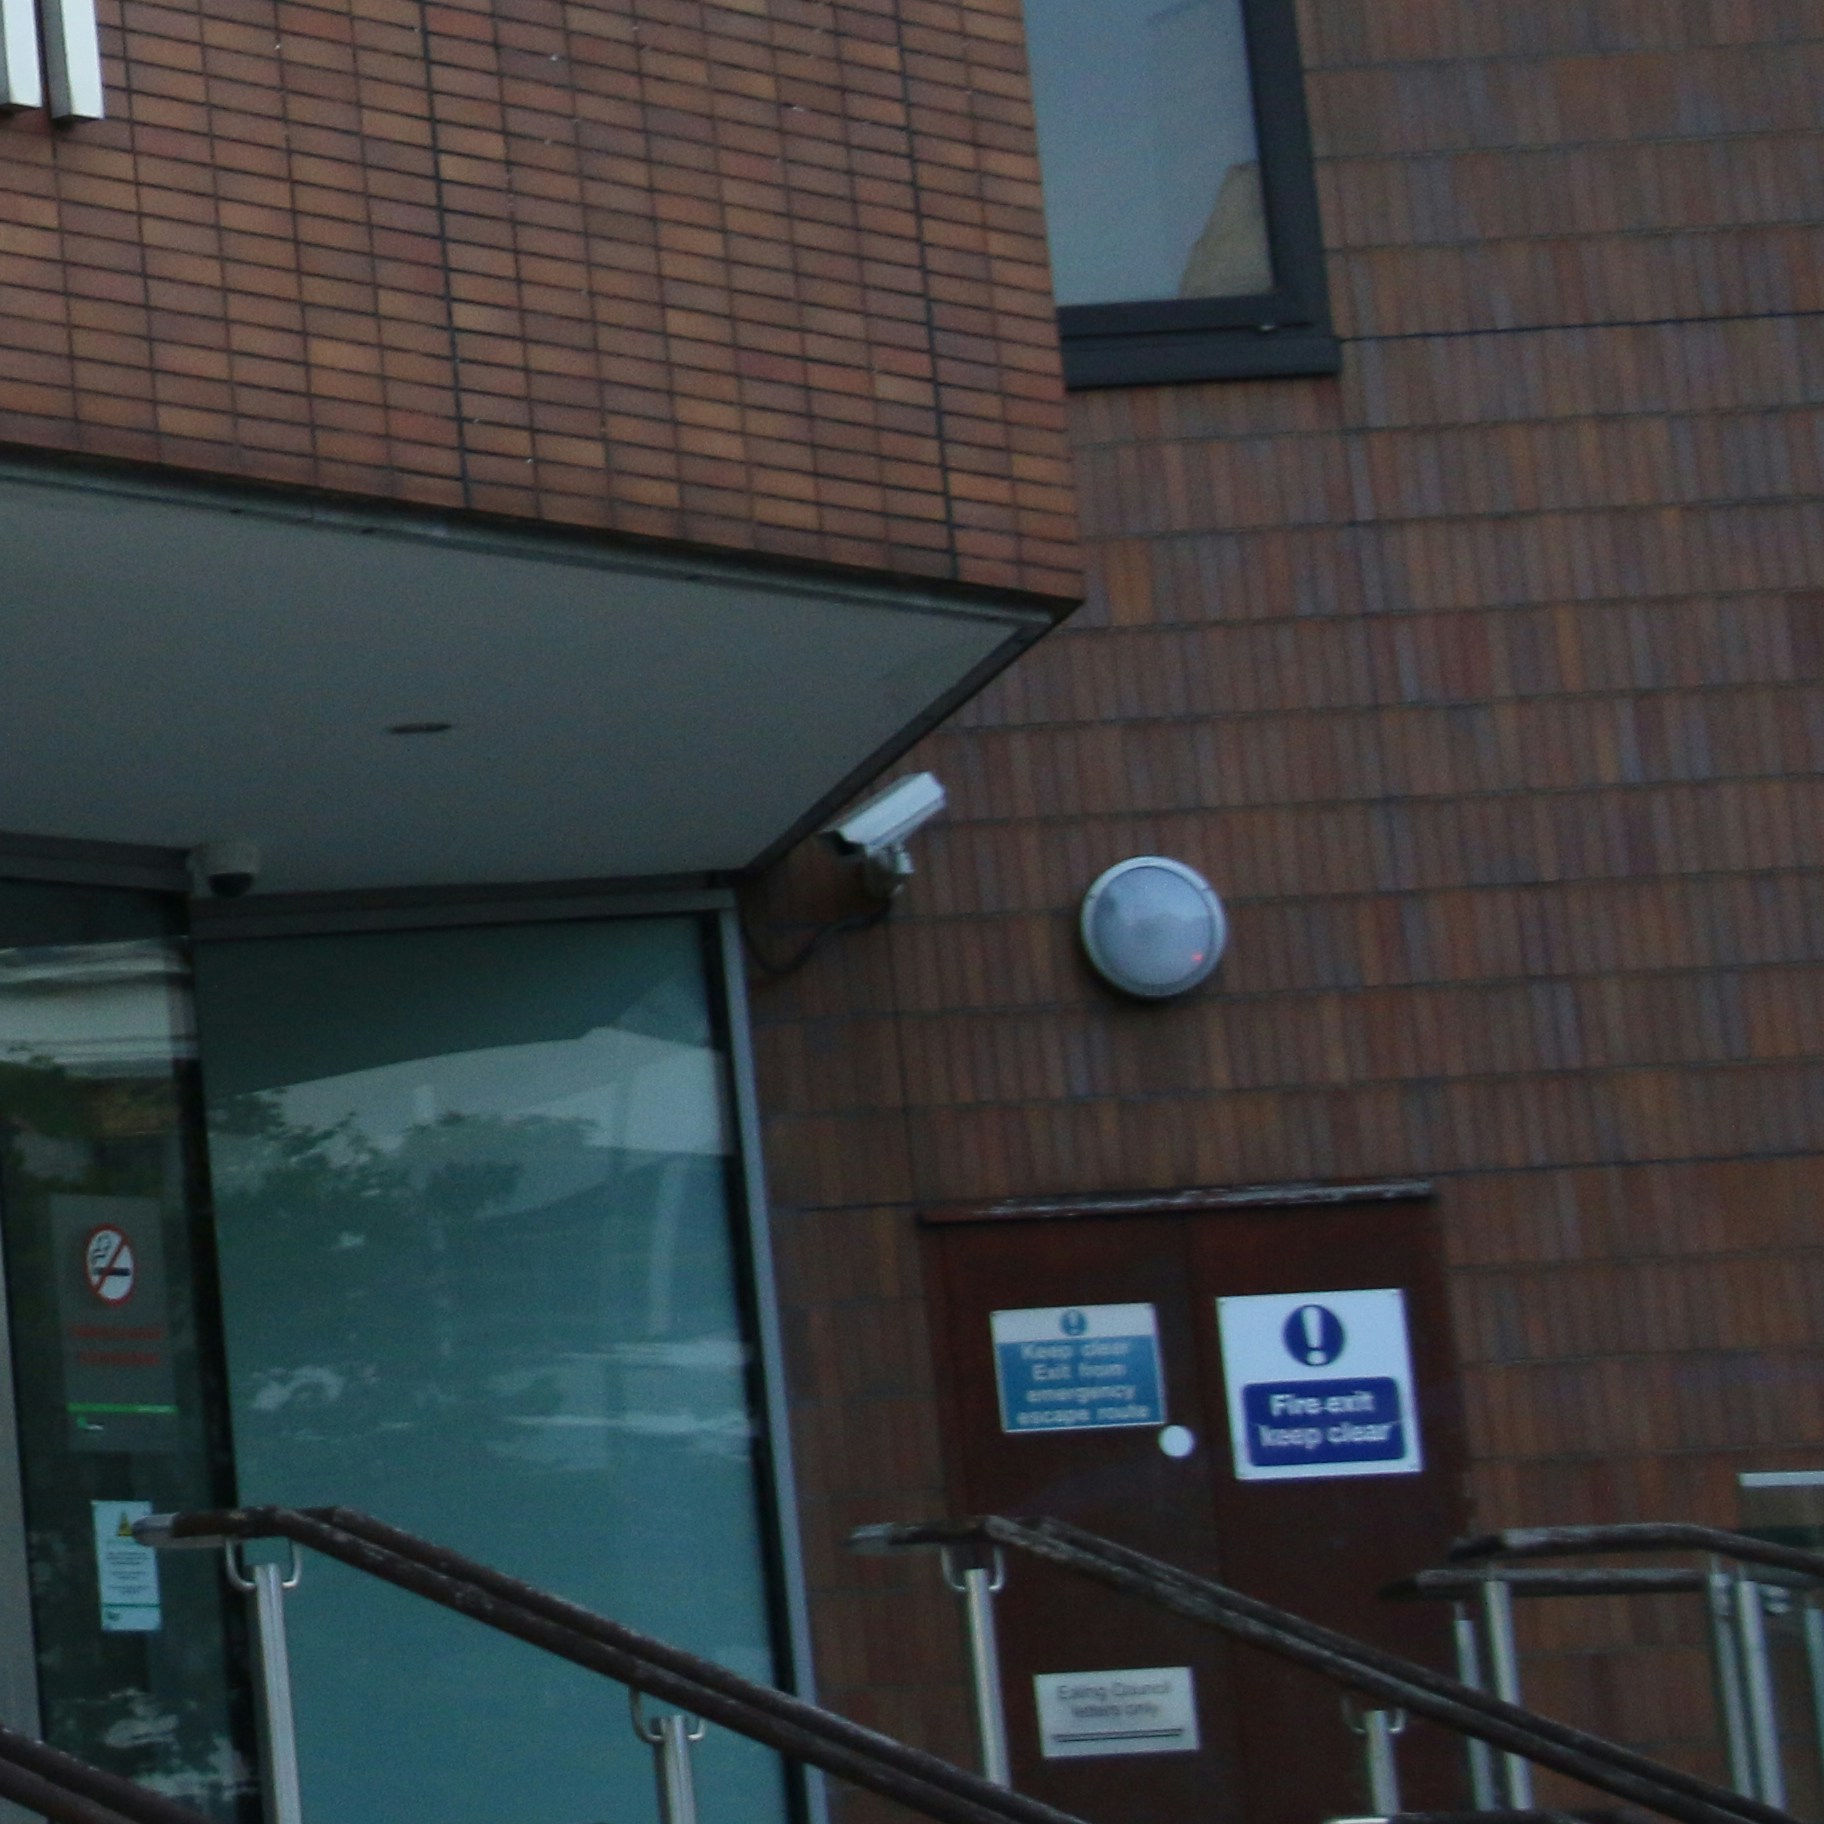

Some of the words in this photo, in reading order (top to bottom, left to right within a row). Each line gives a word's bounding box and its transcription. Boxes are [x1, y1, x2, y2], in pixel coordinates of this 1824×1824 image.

[1021, 1344, 1074, 1360] Keep
[1032, 1364, 1071, 1381] Exit
[1026, 1385, 1136, 1403] emergency
[1269, 1393, 1322, 1417] Fire
[1326, 1390, 1375, 1412] exit
[1258, 1424, 1322, 1449] keep
[1327, 1422, 1392, 1442] clear
